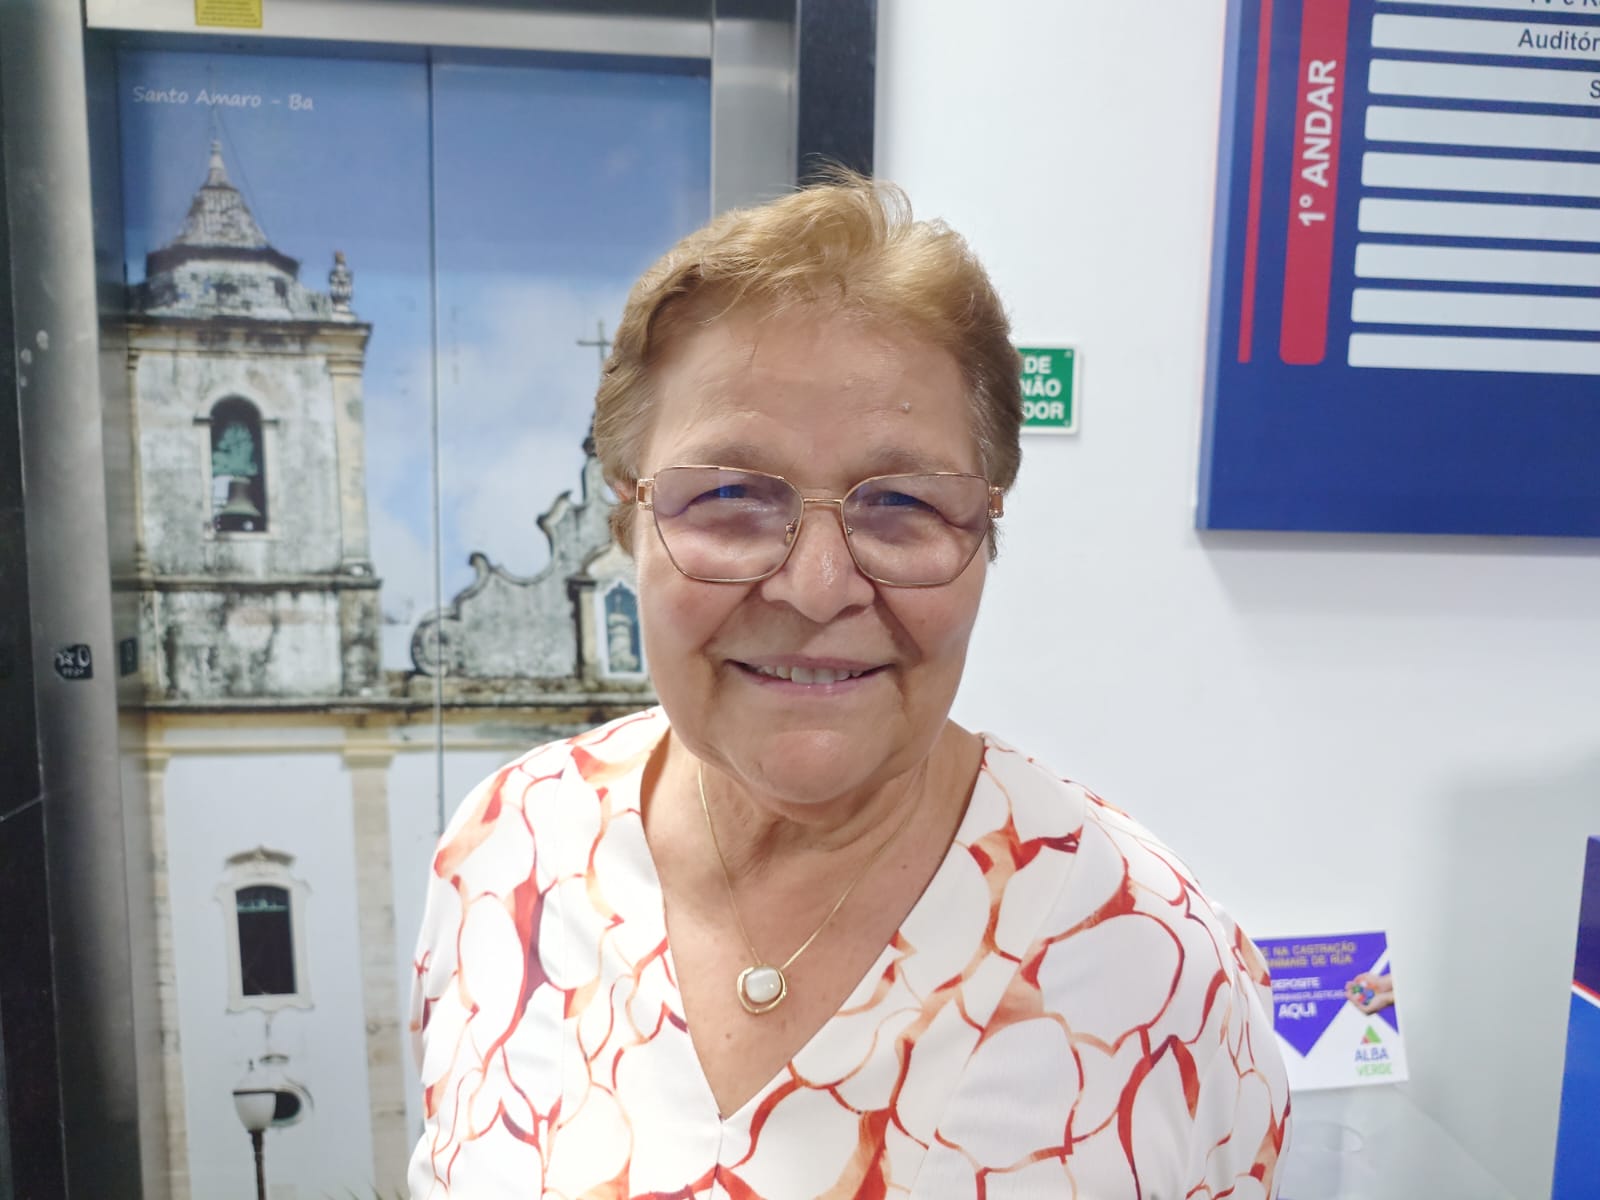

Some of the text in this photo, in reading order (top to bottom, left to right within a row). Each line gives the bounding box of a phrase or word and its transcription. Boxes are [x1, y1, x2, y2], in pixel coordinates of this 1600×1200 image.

[132, 86, 189, 104] Santo
[194, 89, 262, 108] Amaro
[288, 93, 314, 110] Ba
[1301, 59, 1337, 188] ANDAR
[1024, 356, 1052, 374] DE
[1278, 1002, 1317, 1019] AQUI
[1354, 1047, 1389, 1061] ALBA
